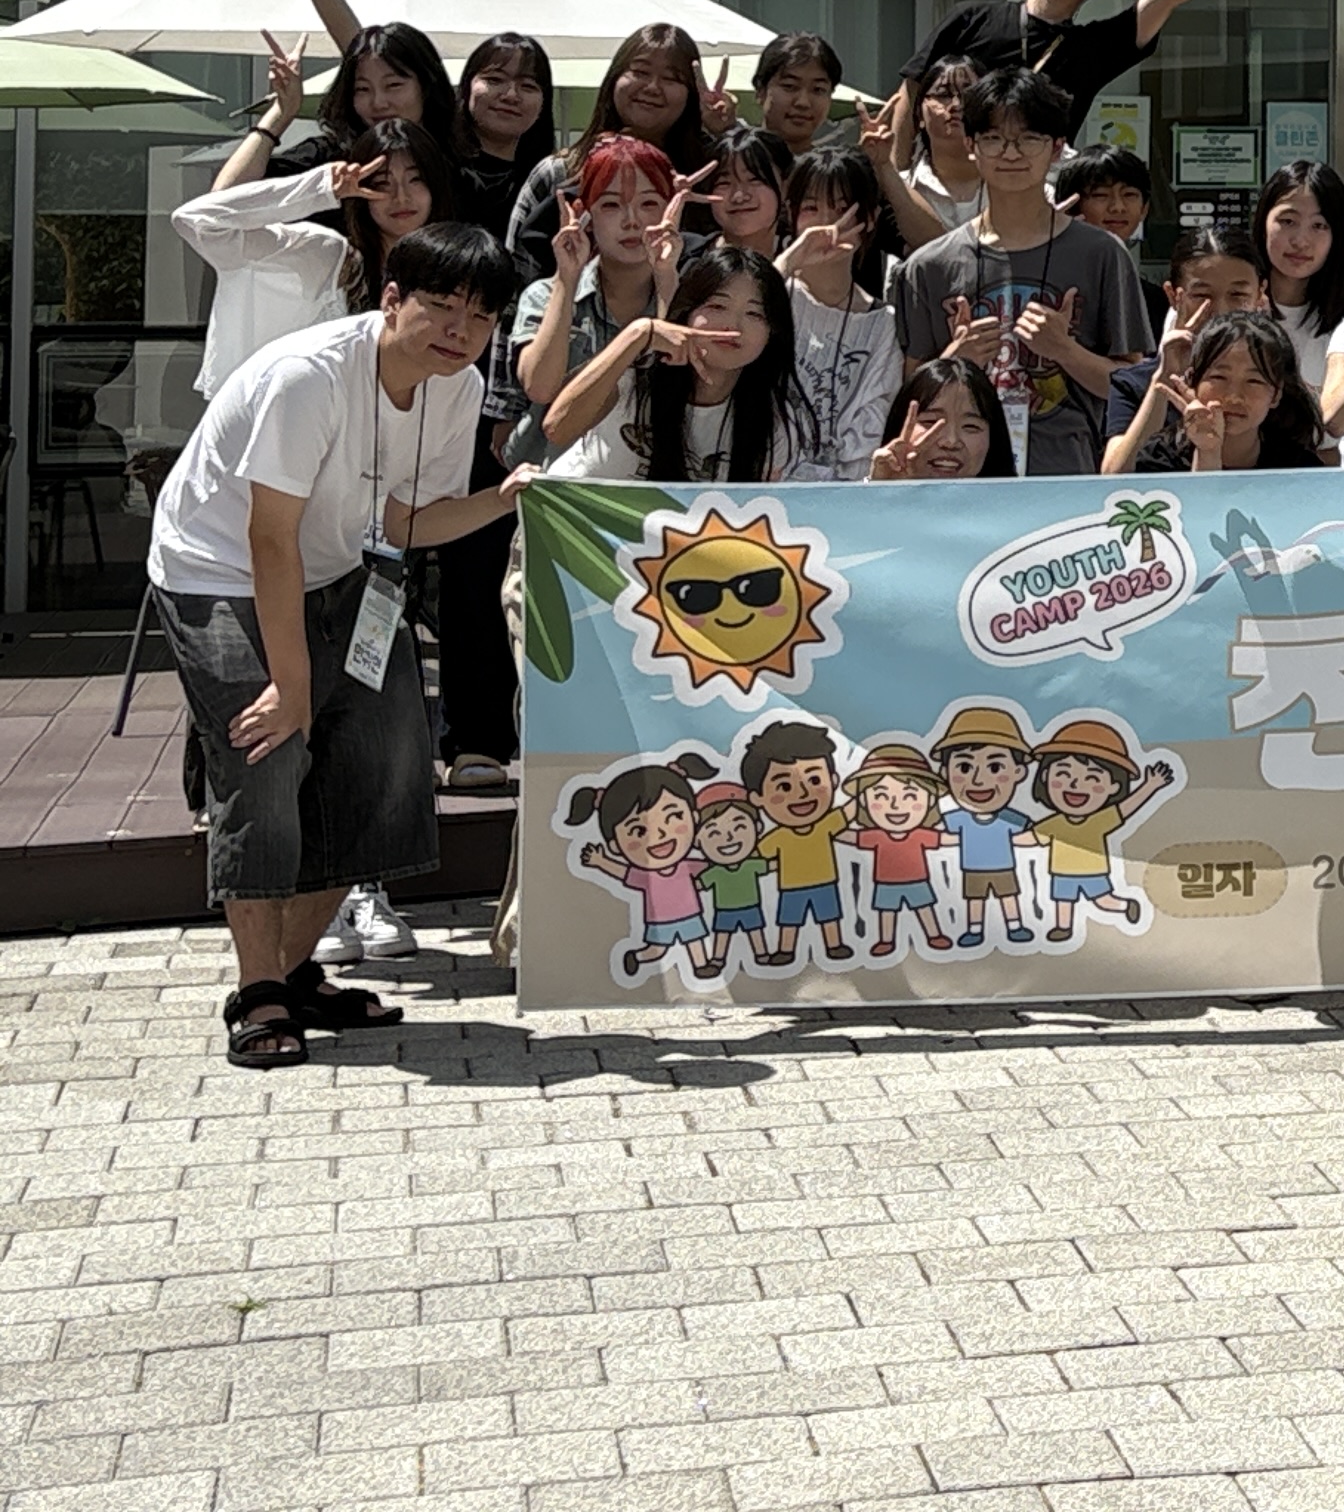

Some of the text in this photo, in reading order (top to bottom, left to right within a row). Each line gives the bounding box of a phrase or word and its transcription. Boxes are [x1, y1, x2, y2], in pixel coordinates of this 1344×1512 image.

[989, 561, 1172, 643] CAMP 2026
[1001, 539, 1125, 604] YOUTH
[1176, 860, 1258, 900] 일자
